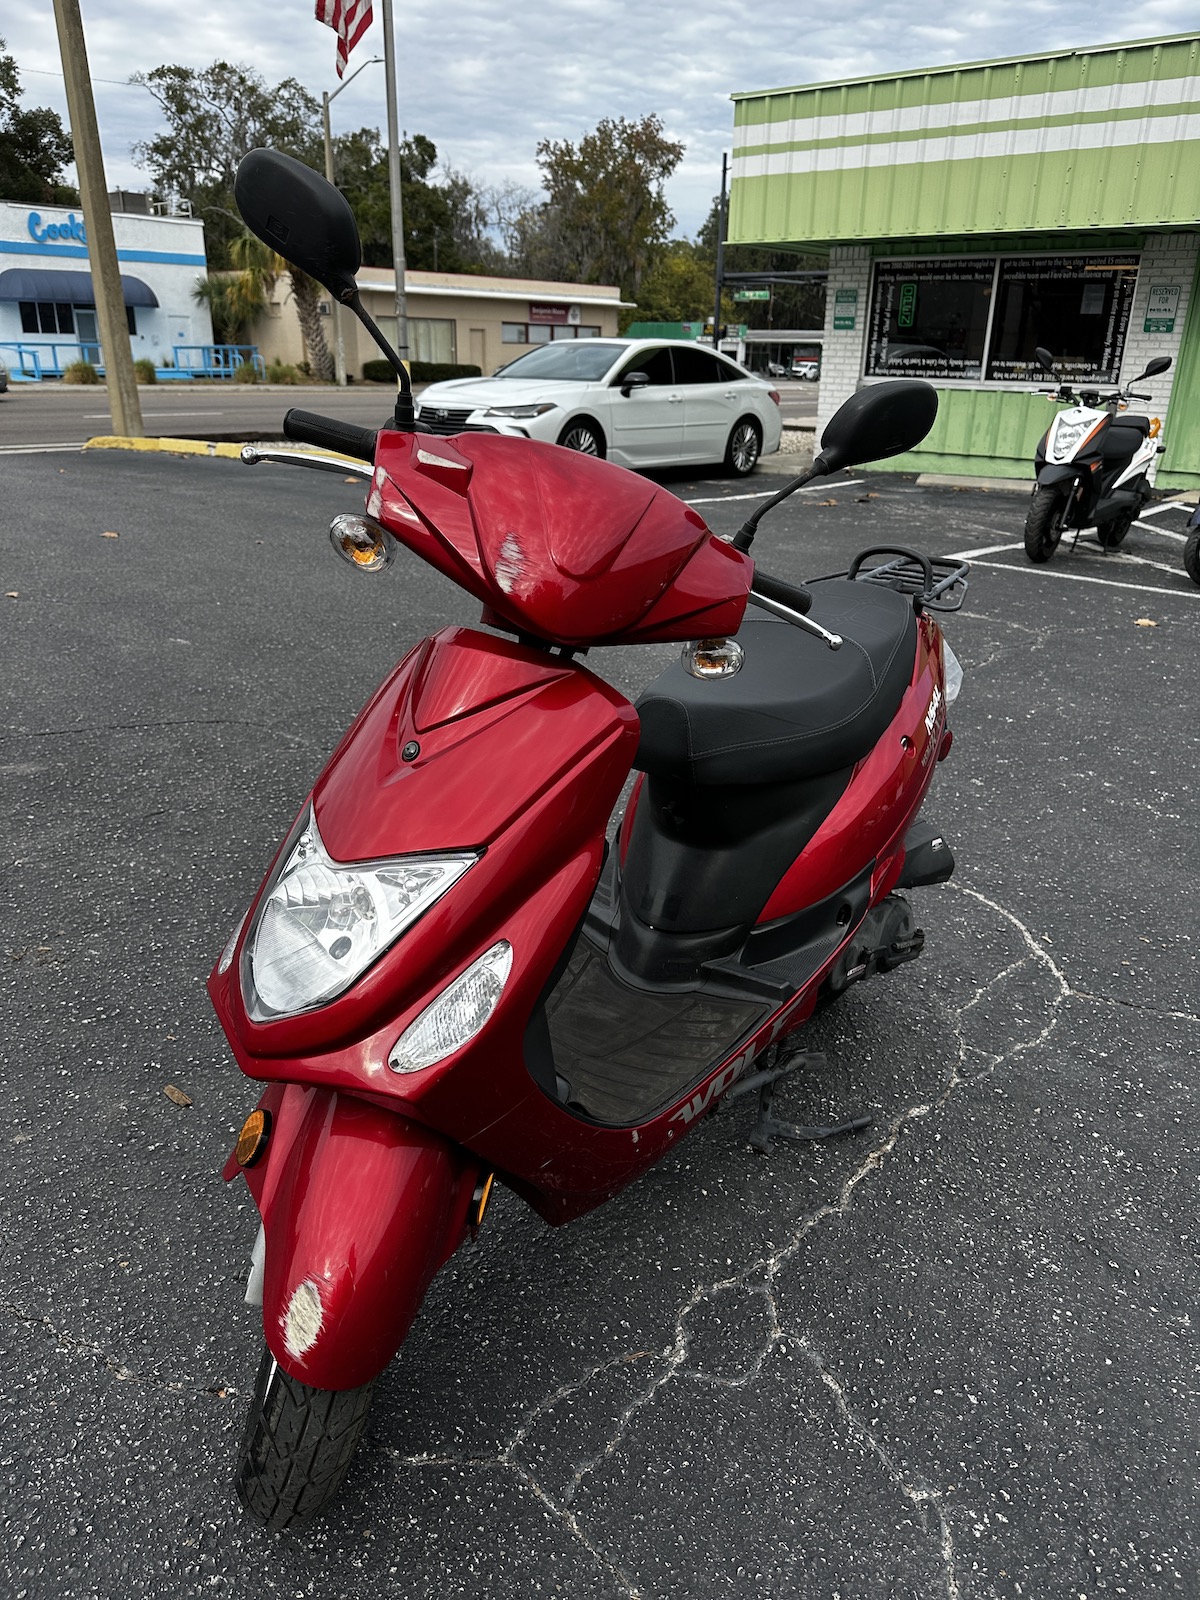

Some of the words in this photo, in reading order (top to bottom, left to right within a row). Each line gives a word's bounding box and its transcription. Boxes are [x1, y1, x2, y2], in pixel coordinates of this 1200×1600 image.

[941, 260, 958, 269] student
[968, 260, 989, 270] struggled
[1047, 259, 1053, 267] to
[1089, 257, 1107, 265] waited
[1107, 256, 1115, 265] 15
[1115, 256, 1136, 265] minutes
[1003, 271, 1026, 280] incredible
[1026, 272, 1039, 280] team
[1040, 271, 1050, 279] and
[1062, 271, 1072, 279] out
[1072, 271, 1078, 279] to
[1078, 271, 1101, 279] influence
[1102, 269, 1113, 278] and
[1113, 290, 1120, 298] an
[1152, 287, 1179, 296] RESERVED
[902, 286, 913, 324] OPEN
[1122, 297, 1133, 311] Then
[1158, 296, 1169, 304] FOR
[1110, 299, 1119, 315] entire
[1118, 316, 1129, 332] drove
[1103, 315, 1116, 347] community.
[1115, 347, 1122, 357] me
[937, 357, 947, 367] Stay
[1000, 360, 1005, 368] to
[1100, 347, 1112, 371] Welcome
[1113, 357, 1121, 368] with
[1005, 360, 1027, 369] Welcome
[1034, 361, 1041, 369] to
[1063, 362, 1092, 371] Gainesville.
[874, 366, 889, 376] having
[889, 368, 904, 376] without
[915, 369, 926, 378] from
[925, 369, 936, 377] and
[939, 369, 949, 377] get
[948, 370, 967, 379] students
[992, 370, 1004, 380] help
[1004, 372, 1010, 380] to
[1009, 372, 1018, 380] out
[1017, 373, 1026, 381] set
[1074, 373, 1109, 384] unforgettable
[924, 684, 942, 736] NS4L
[668, 991, 808, 1124] WOLF
